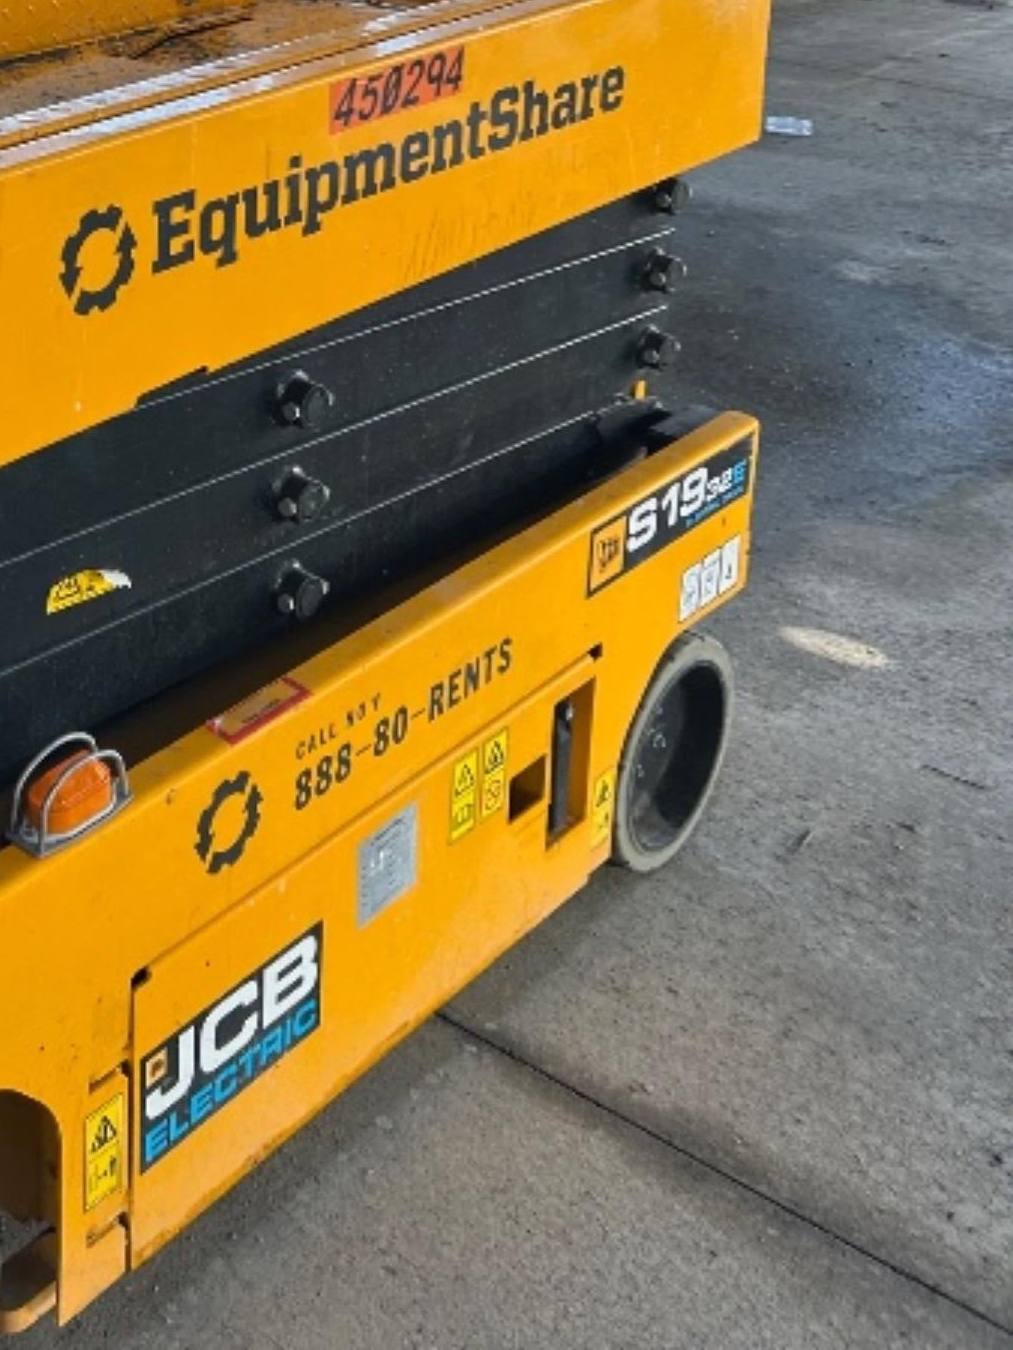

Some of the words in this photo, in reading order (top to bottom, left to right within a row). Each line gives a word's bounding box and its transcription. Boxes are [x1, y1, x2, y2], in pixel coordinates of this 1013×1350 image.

[151, 64, 625, 274] EquipmentShare
[331, 46, 465, 127] 450294
[294, 637, 514, 811] 888-80-RENTS
[295, 722, 336, 760] CALL
[144, 998, 317, 1163] ELECTRIC
[145, 934, 319, 1121] JCB
